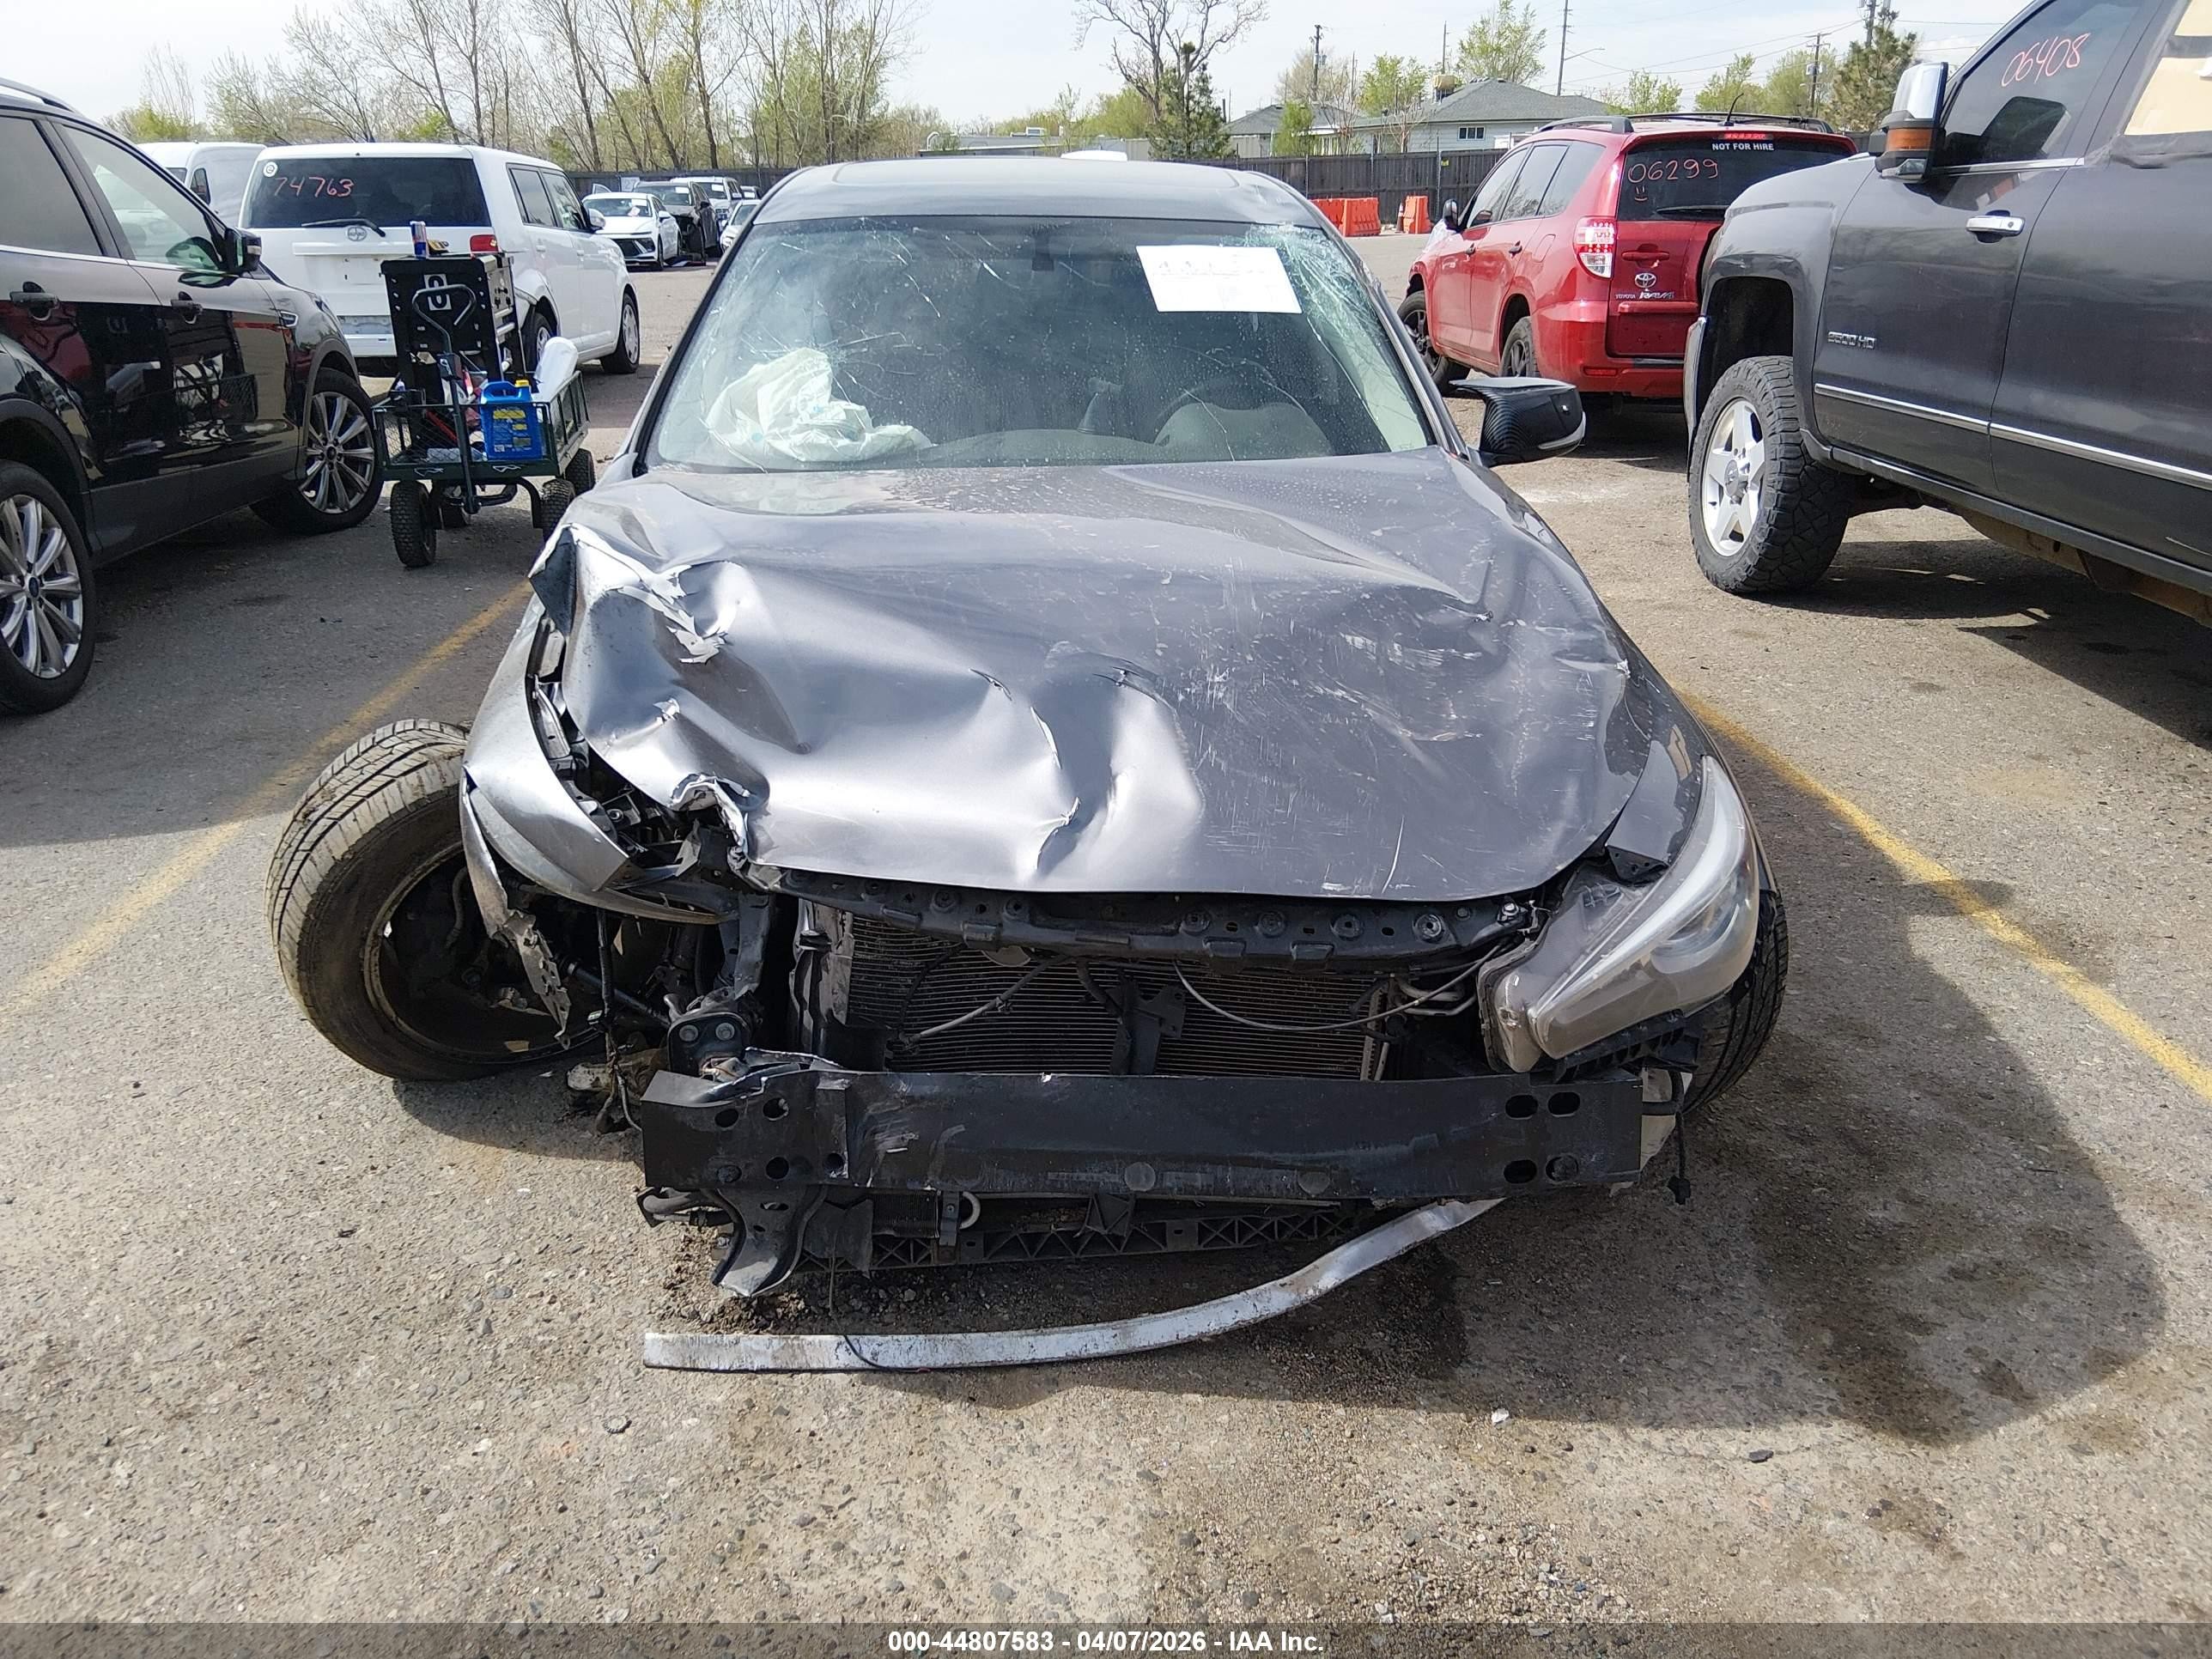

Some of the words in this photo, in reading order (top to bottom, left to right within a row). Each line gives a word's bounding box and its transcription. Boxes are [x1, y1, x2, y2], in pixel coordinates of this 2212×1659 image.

[2001, 33, 2092, 88] 06408
[1711, 143, 1730, 151] NOT
[1732, 143, 1752, 151] FOR
[1753, 143, 1775, 151] HIRE
[1628, 158, 1718, 184] 06299
[274, 176, 355, 198] 74763
